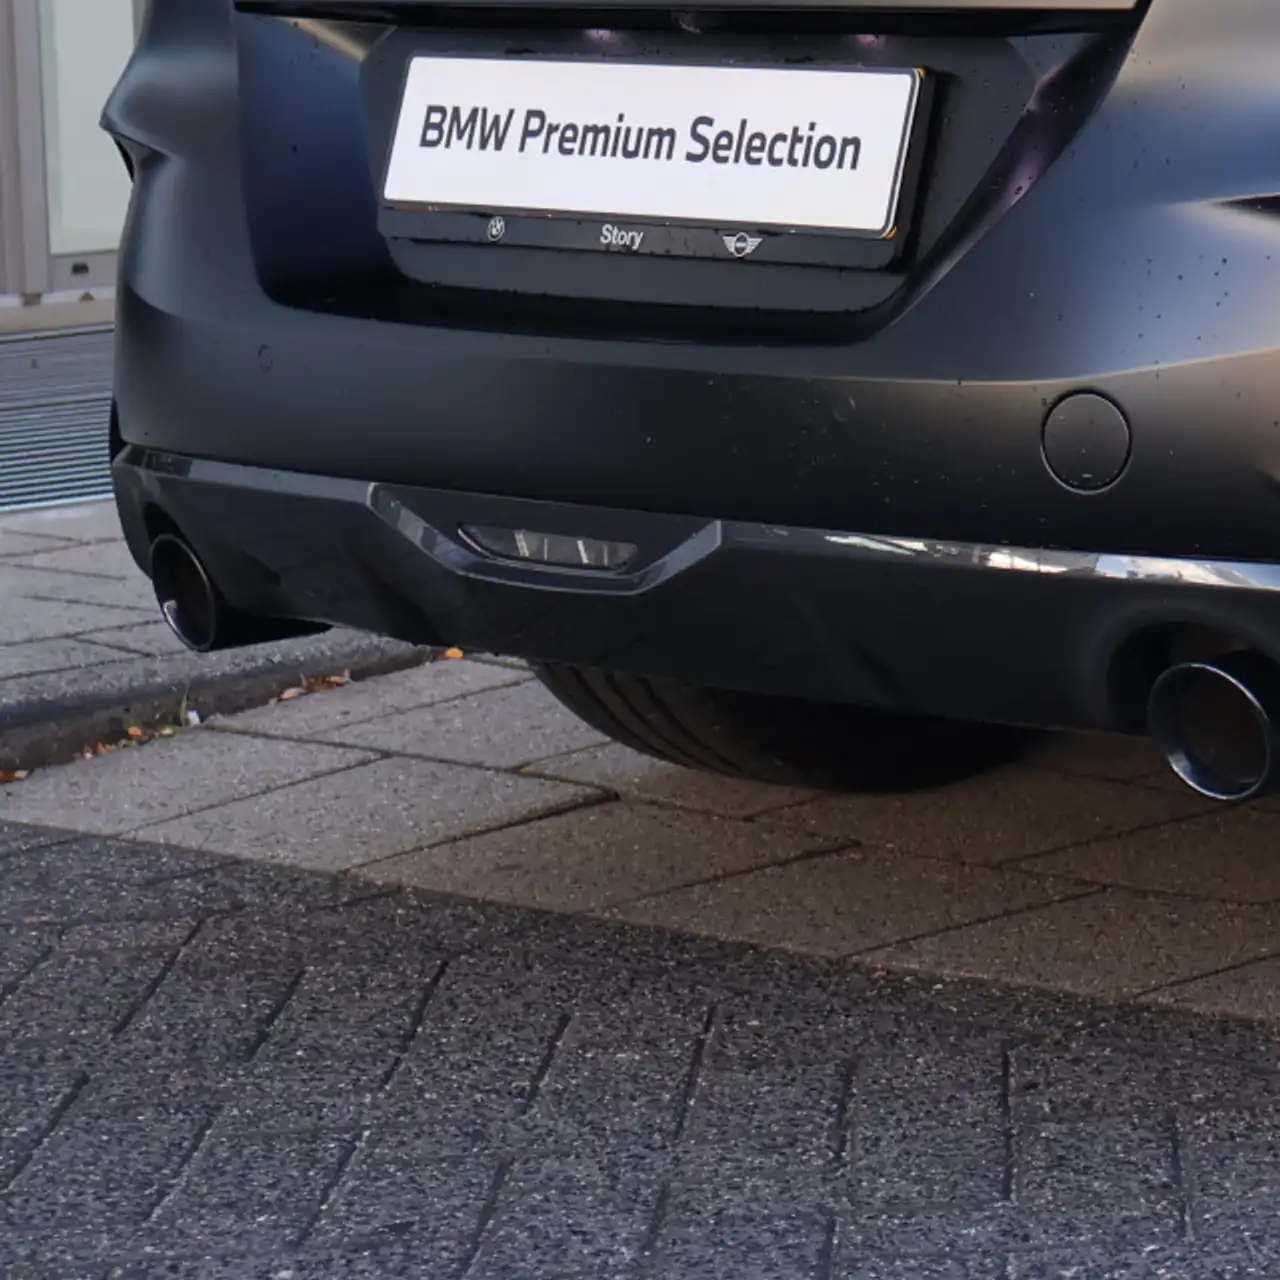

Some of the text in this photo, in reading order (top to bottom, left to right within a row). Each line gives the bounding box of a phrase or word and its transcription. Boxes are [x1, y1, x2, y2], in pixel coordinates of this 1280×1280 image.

[419, 104, 862, 171] BMW Premium Selection
[600, 223, 644, 250] Story
